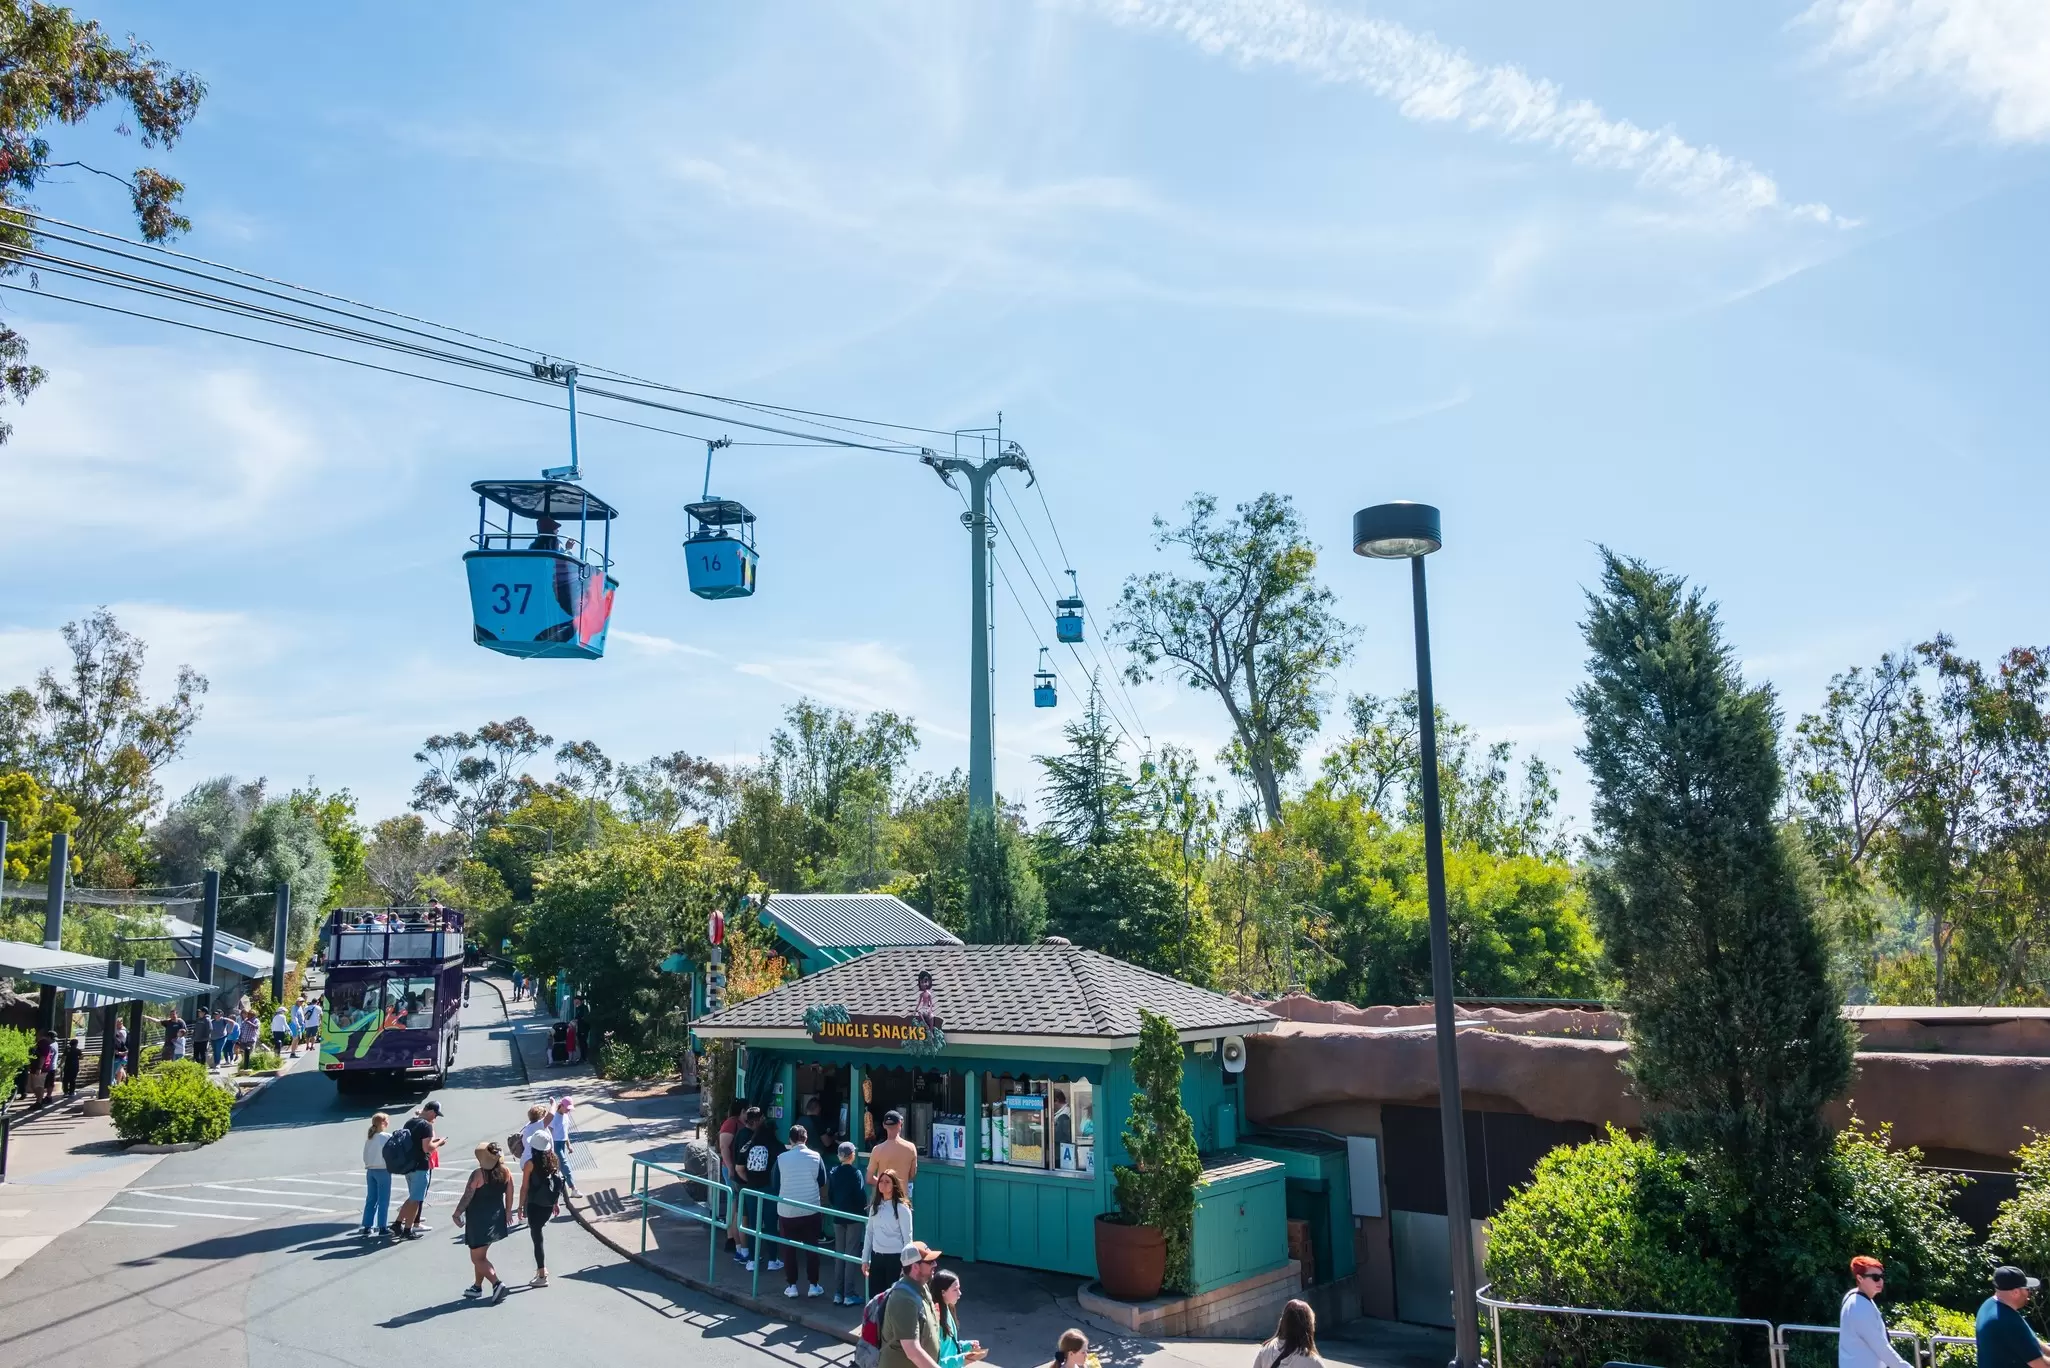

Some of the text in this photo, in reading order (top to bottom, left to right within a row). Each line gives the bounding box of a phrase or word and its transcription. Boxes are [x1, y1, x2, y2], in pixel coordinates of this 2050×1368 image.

[701, 553, 721, 572] 16
[491, 583, 532, 615] 37
[820, 1021, 926, 1041] JUNGLE SNACKS
[1063, 1147, 1072, 1161] A
